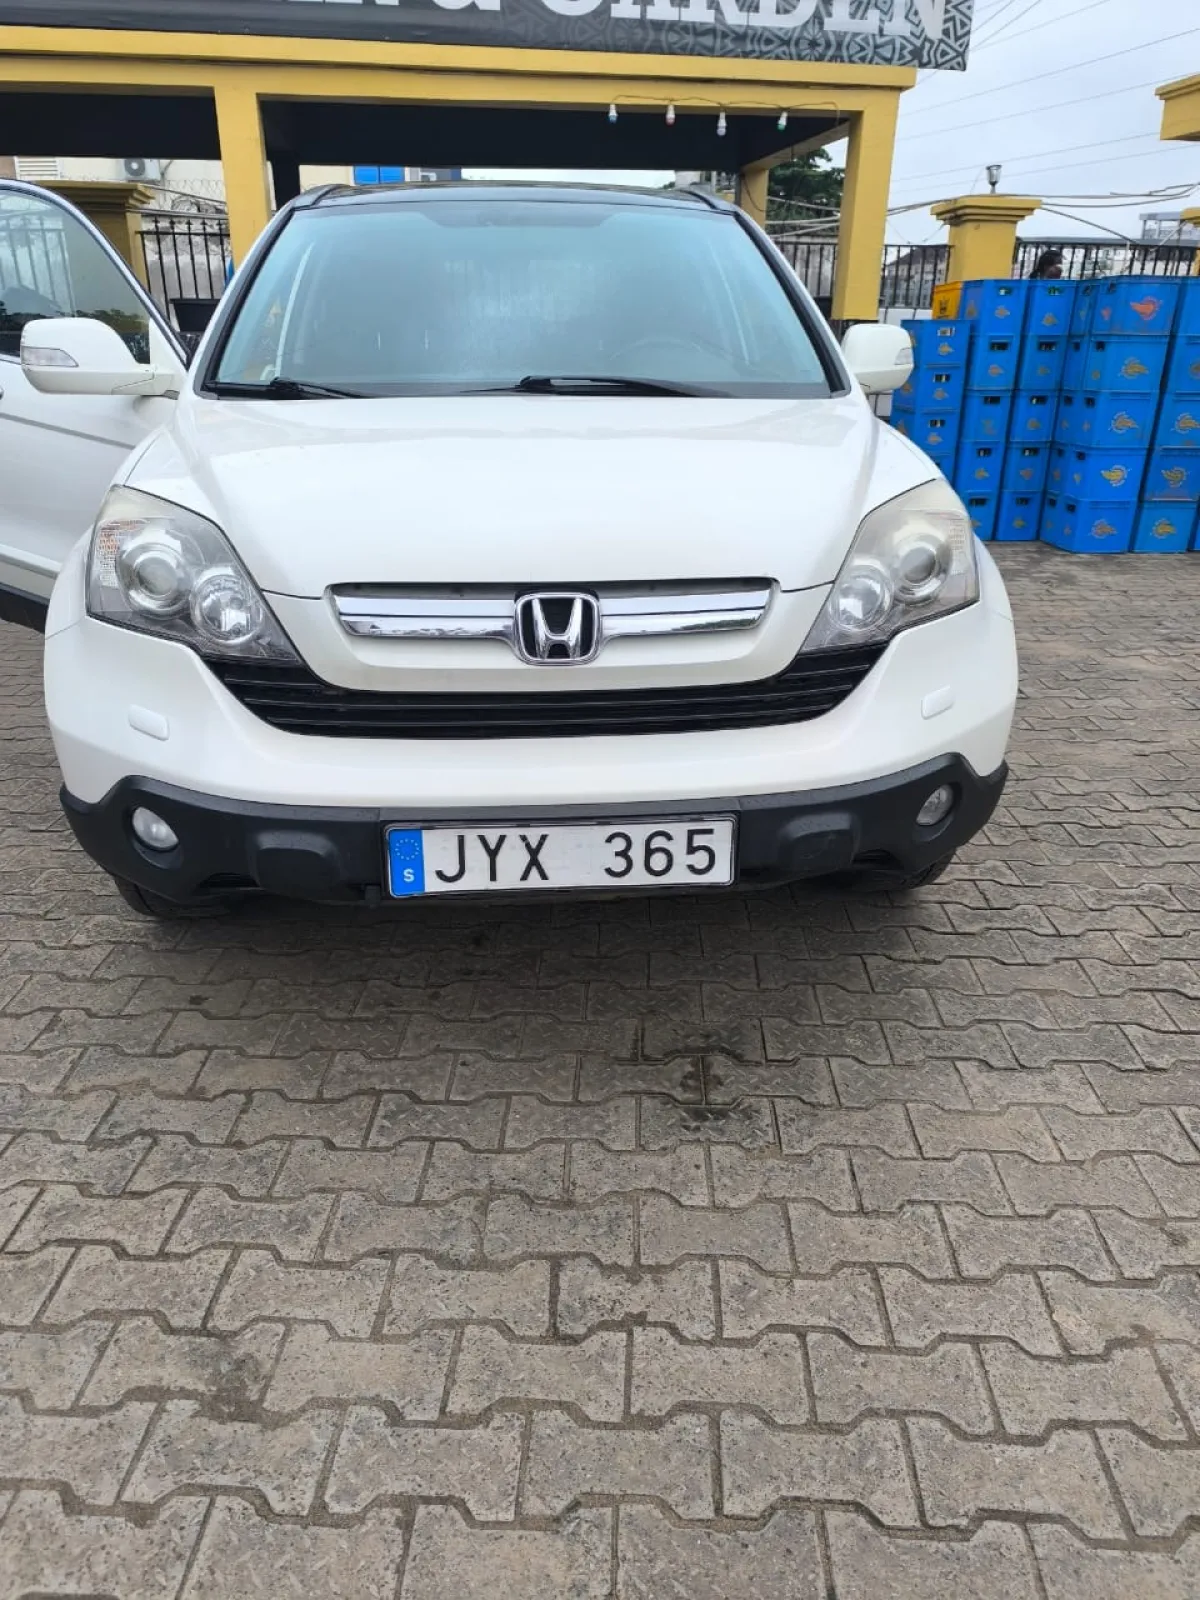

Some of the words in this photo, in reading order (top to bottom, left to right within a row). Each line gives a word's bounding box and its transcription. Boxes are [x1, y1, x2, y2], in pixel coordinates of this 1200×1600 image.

[435, 834, 550, 883] JYX
[604, 828, 716, 878] 365
[403, 869, 415, 882] S
